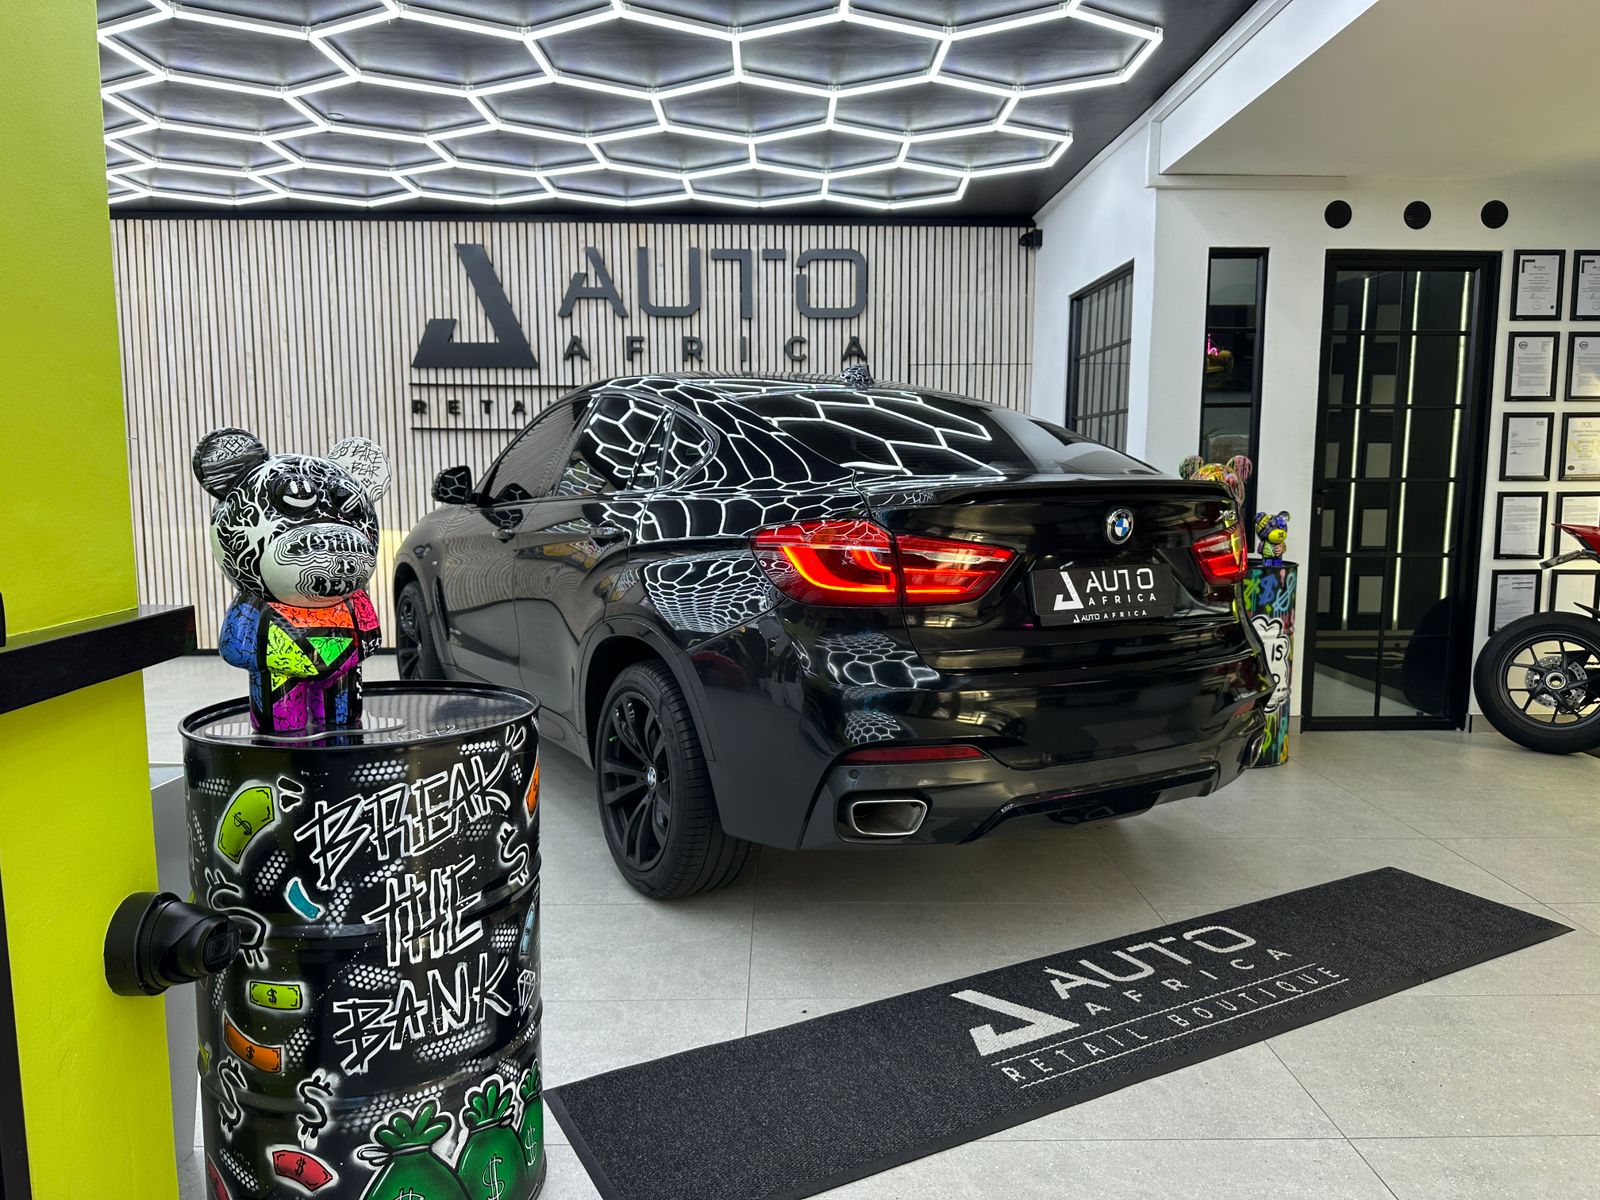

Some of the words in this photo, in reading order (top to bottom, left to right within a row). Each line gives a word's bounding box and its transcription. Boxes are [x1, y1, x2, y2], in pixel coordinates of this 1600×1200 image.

[558, 246, 868, 319] AUTO
[563, 335, 867, 363] AFRICA
[1081, 613, 1100, 622] AUTO
[1103, 609, 1147, 619] AFRICA
[1085, 568, 1154, 593] AUTO
[1088, 593, 1156, 606] AFRICA
[295, 753, 512, 890] BREAK
[363, 855, 486, 968] THE
[1044, 925, 1257, 1000] AUTO
[1086, 947, 1293, 1016] AFRICA
[332, 952, 513, 1075] BANK
[1001, 1028, 1149, 1082] RETAIL
[1168, 965, 1340, 1028] BOUTIQUE
